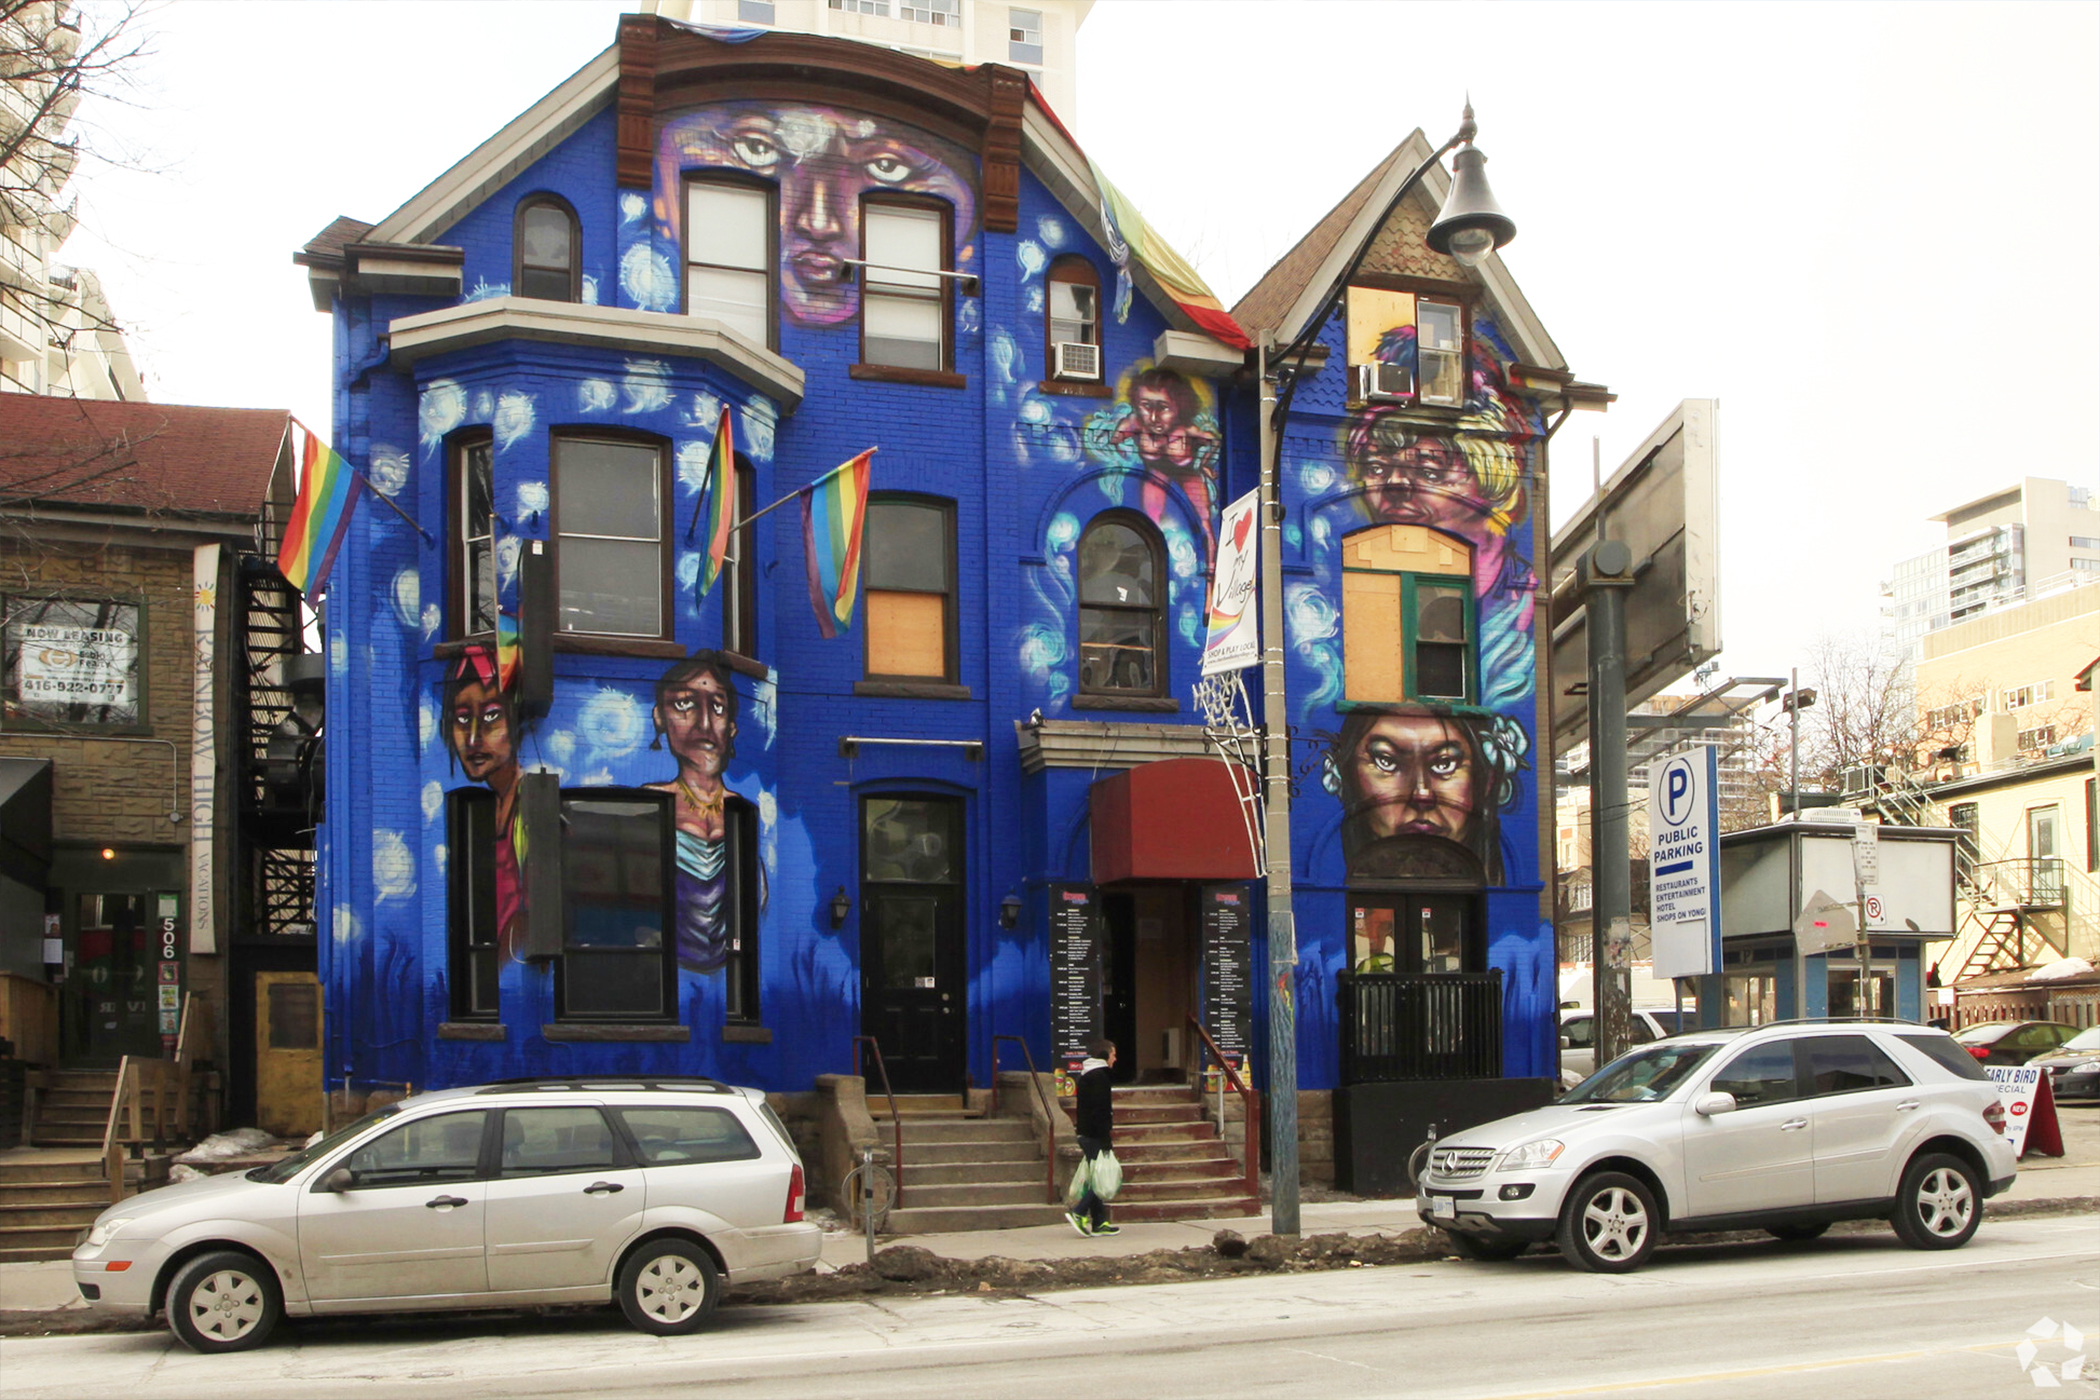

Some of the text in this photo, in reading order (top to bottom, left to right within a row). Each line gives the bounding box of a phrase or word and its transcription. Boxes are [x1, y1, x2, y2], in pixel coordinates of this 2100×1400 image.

[1225, 512, 1238, 547] I
[1216, 568, 1253, 608] Village
[27, 628, 123, 643] NOW LEASING
[24, 680, 124, 695] 416-922-0777
[193, 629, 214, 930] RAINBOW HIGH VACATIONS
[1669, 768, 1687, 816] P
[1658, 825, 1698, 846] PUBLIC
[1654, 841, 1703, 863] PARKING
[1656, 877, 1698, 892] RESTAURANTS
[1656, 886, 1706, 903] ENTERTAINMENT
[1656, 902, 1676, 912] HOTEL
[1656, 912, 1676, 923] SHOPS
[1677, 911, 1686, 920] ON
[162, 918, 175, 959] 506
[2014, 1069, 2037, 1084] BIRD
[2012, 1105, 2026, 1113] NEW
